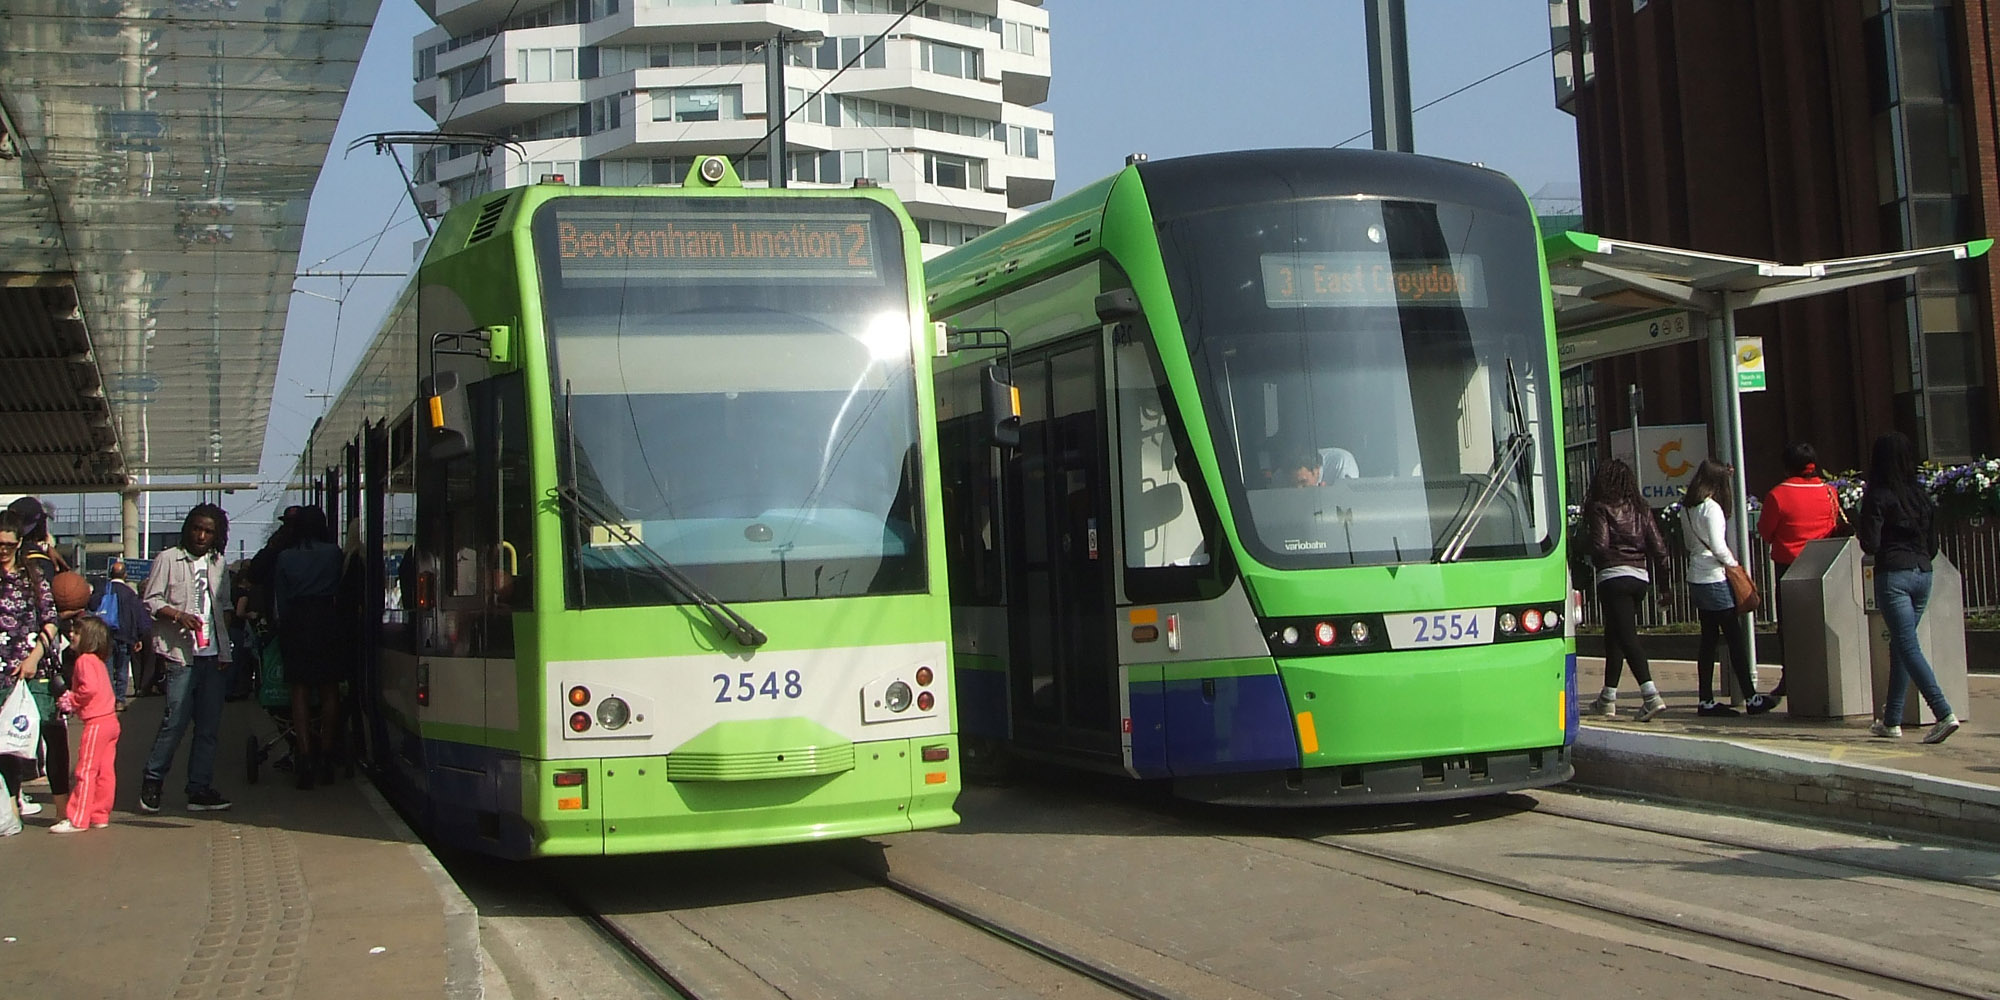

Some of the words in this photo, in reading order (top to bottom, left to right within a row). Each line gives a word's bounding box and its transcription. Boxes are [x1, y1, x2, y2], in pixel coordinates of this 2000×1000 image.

[560, 222, 725, 259] Beckenham
[731, 223, 842, 259] Junction
[845, 224, 868, 266] 2
[1280, 267, 1293, 297] 3
[1313, 264, 1366, 294] East
[1372, 265, 1467, 300] Croydon
[1642, 485, 1689, 498] CHAR
[1284, 539, 1327, 551] variobahn
[1412, 614, 1480, 643] 2554
[712, 669, 804, 704] 2548
